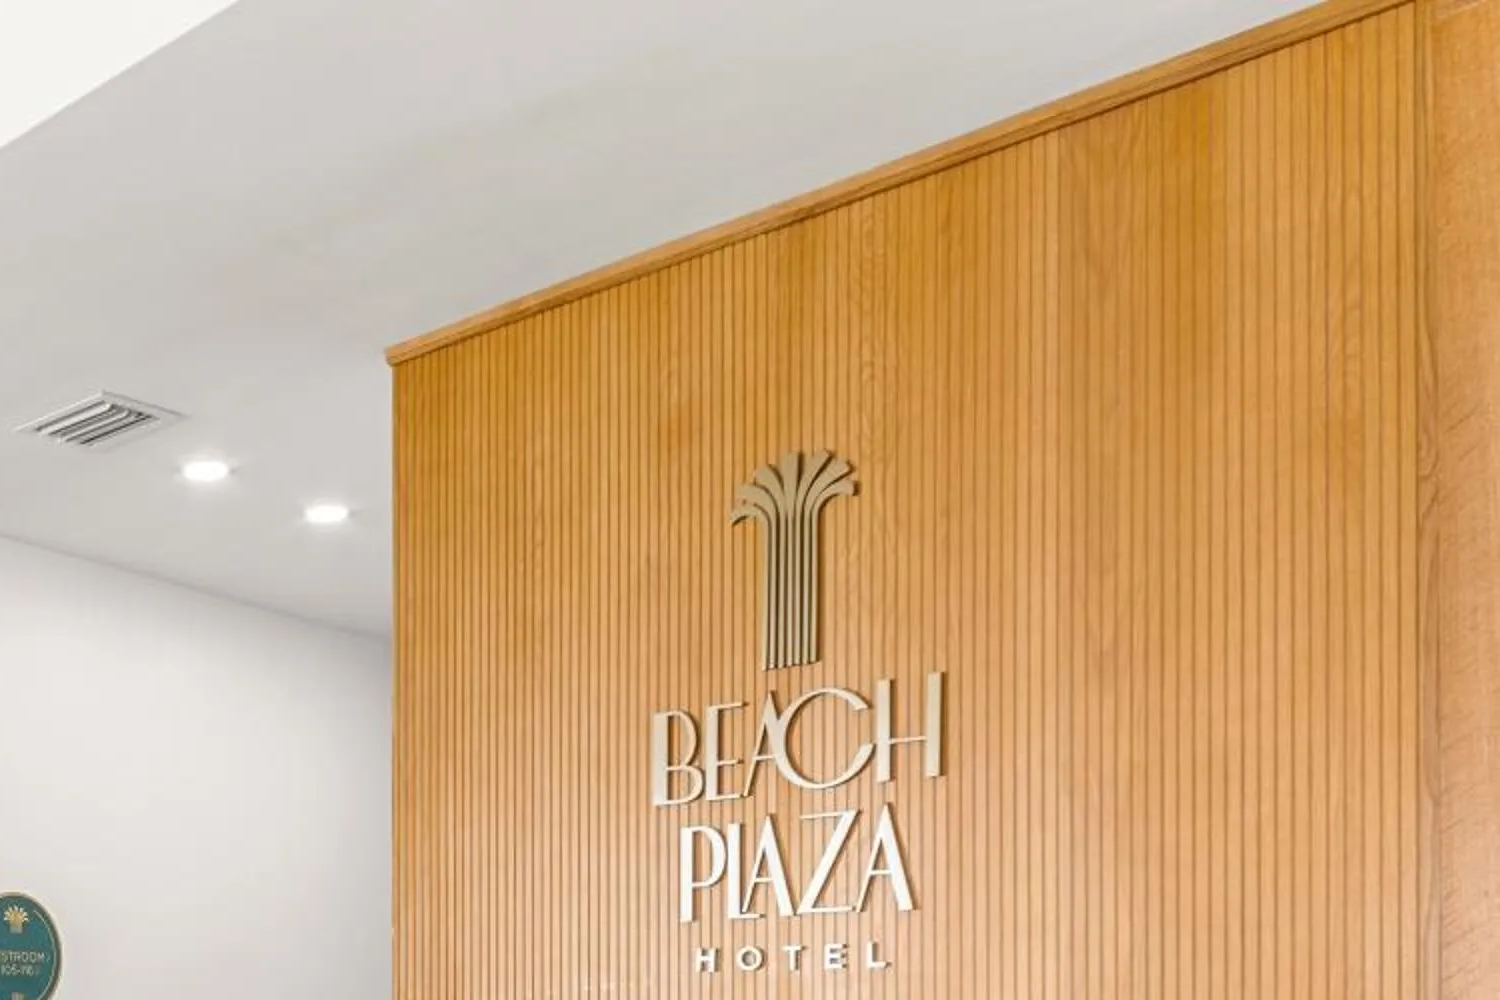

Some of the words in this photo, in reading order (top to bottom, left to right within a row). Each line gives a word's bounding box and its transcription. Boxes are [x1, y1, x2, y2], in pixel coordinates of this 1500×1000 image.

[653, 671, 945, 807] BEACH
[680, 803, 919, 924] PLAZA
[695, 940, 892, 972] HOTEL
